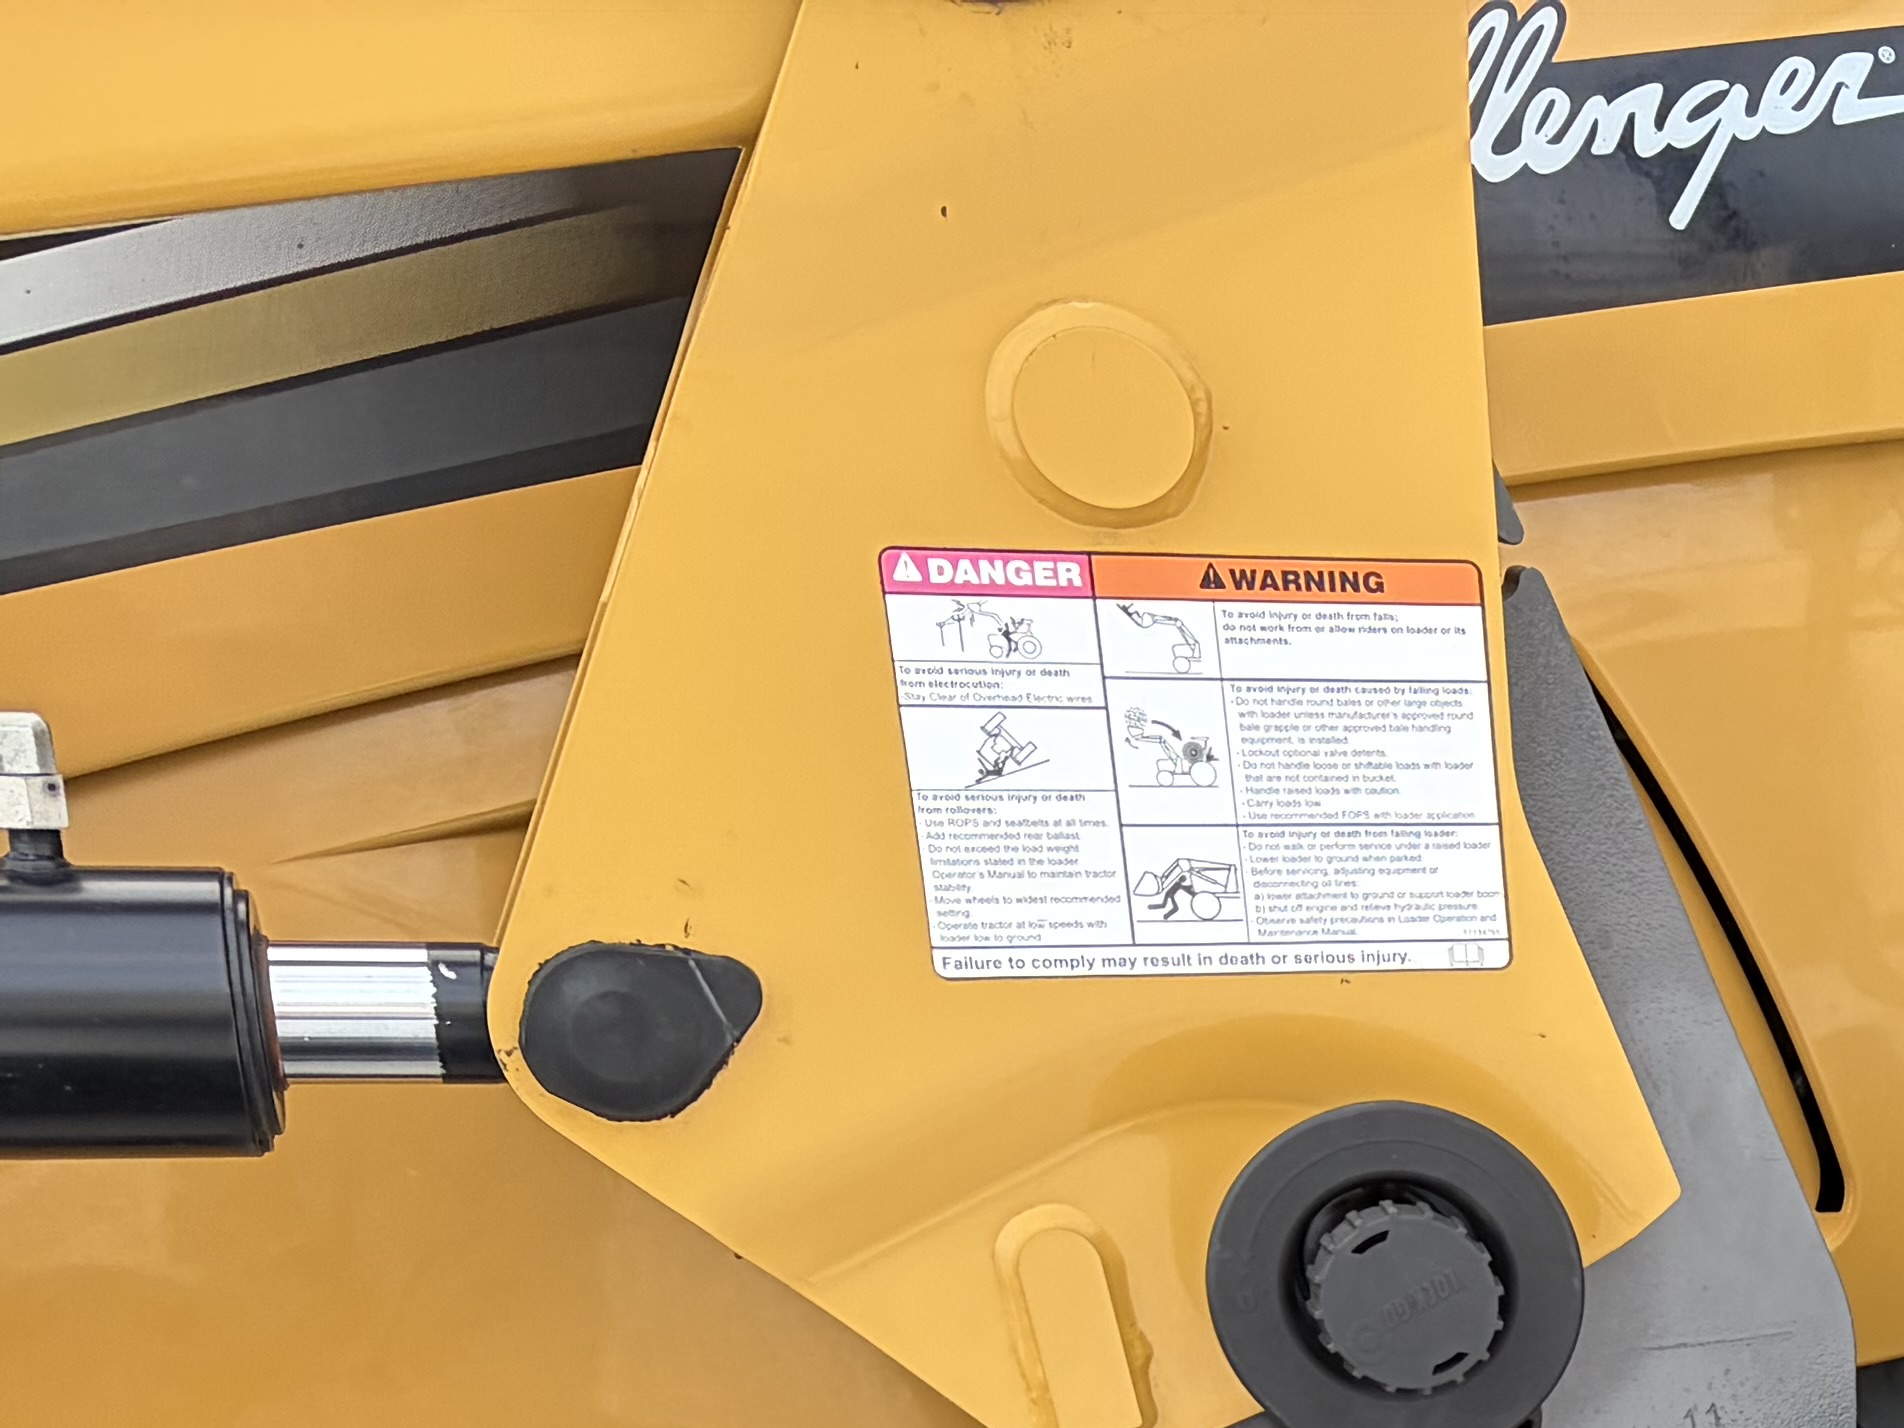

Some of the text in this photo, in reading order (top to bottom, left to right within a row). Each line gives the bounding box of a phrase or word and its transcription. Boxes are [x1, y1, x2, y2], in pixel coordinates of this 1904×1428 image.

[929, 557, 1083, 588] DANGER
[1229, 567, 1386, 595] WARNING
[942, 949, 1411, 972] Failure to comply may result in death or serious injury.
